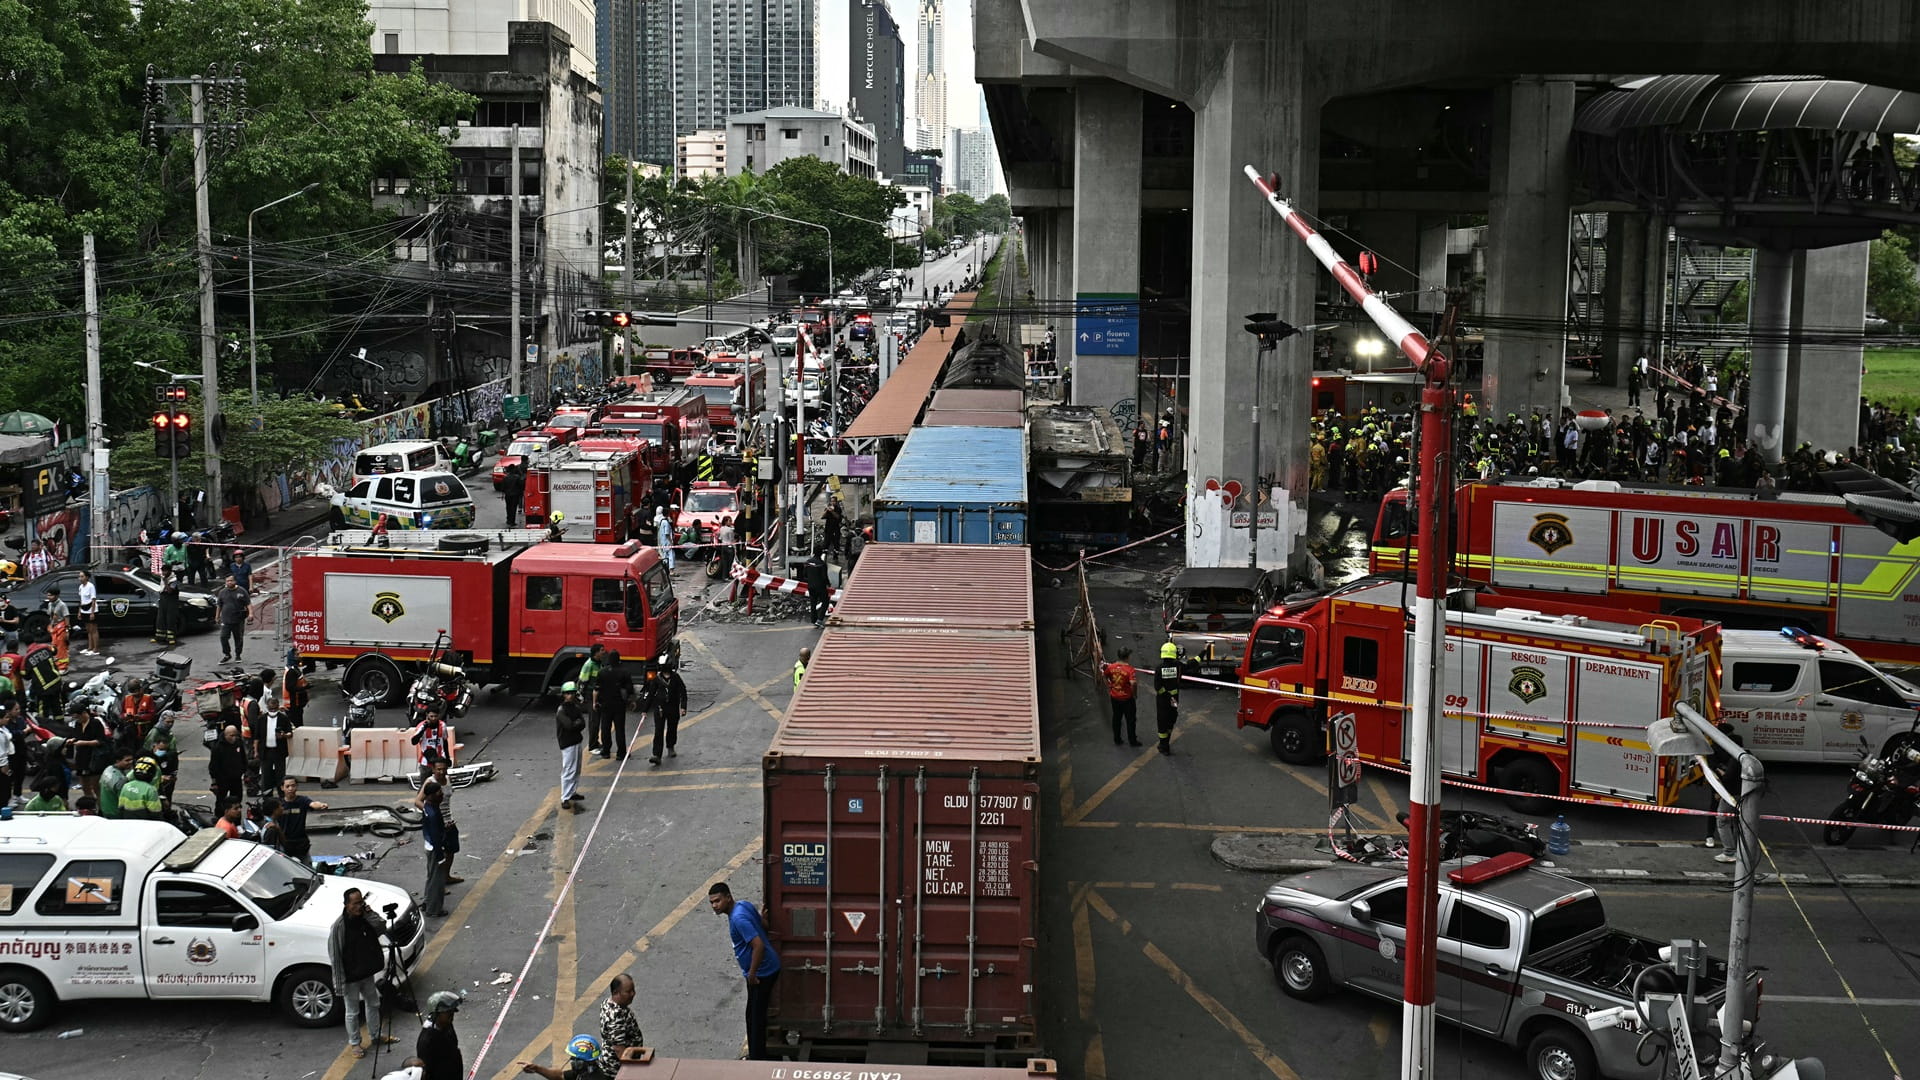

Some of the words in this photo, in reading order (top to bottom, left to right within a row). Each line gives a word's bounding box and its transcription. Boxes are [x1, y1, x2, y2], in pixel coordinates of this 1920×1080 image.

[866, 11, 874, 40] HOTEL
[865, 42, 874, 89] Mercure
[1631, 516, 1781, 565] USAR
[1699, 561, 1724, 569] SEARCH
[295, 625, 319, 633] 045-2
[304, 644, 320, 652] 199
[1511, 651, 1548, 665] RESCUE
[1585, 661, 1651, 680] DEPARTMENT
[1341, 675, 1378, 693] BFRD
[849, 799, 862, 809] GL
[944, 795, 969, 808] GLDU
[980, 795, 1018, 809] 577907
[1023, 796, 1032, 810] 0
[980, 812, 1005, 825] 22G1
[783, 844, 825, 856] GOLD
[925, 840, 954, 853] MGW.
[925, 854, 956, 867] TARE.
[925, 867, 949, 881] NET.
[925, 881, 967, 895] CU.CAP.
[156, 972, 257, 986] สนับสนุนกิจการตำรวจ
[792, 1069, 852, 1080] 298930
[858, 1071, 902, 1080] CAAU
